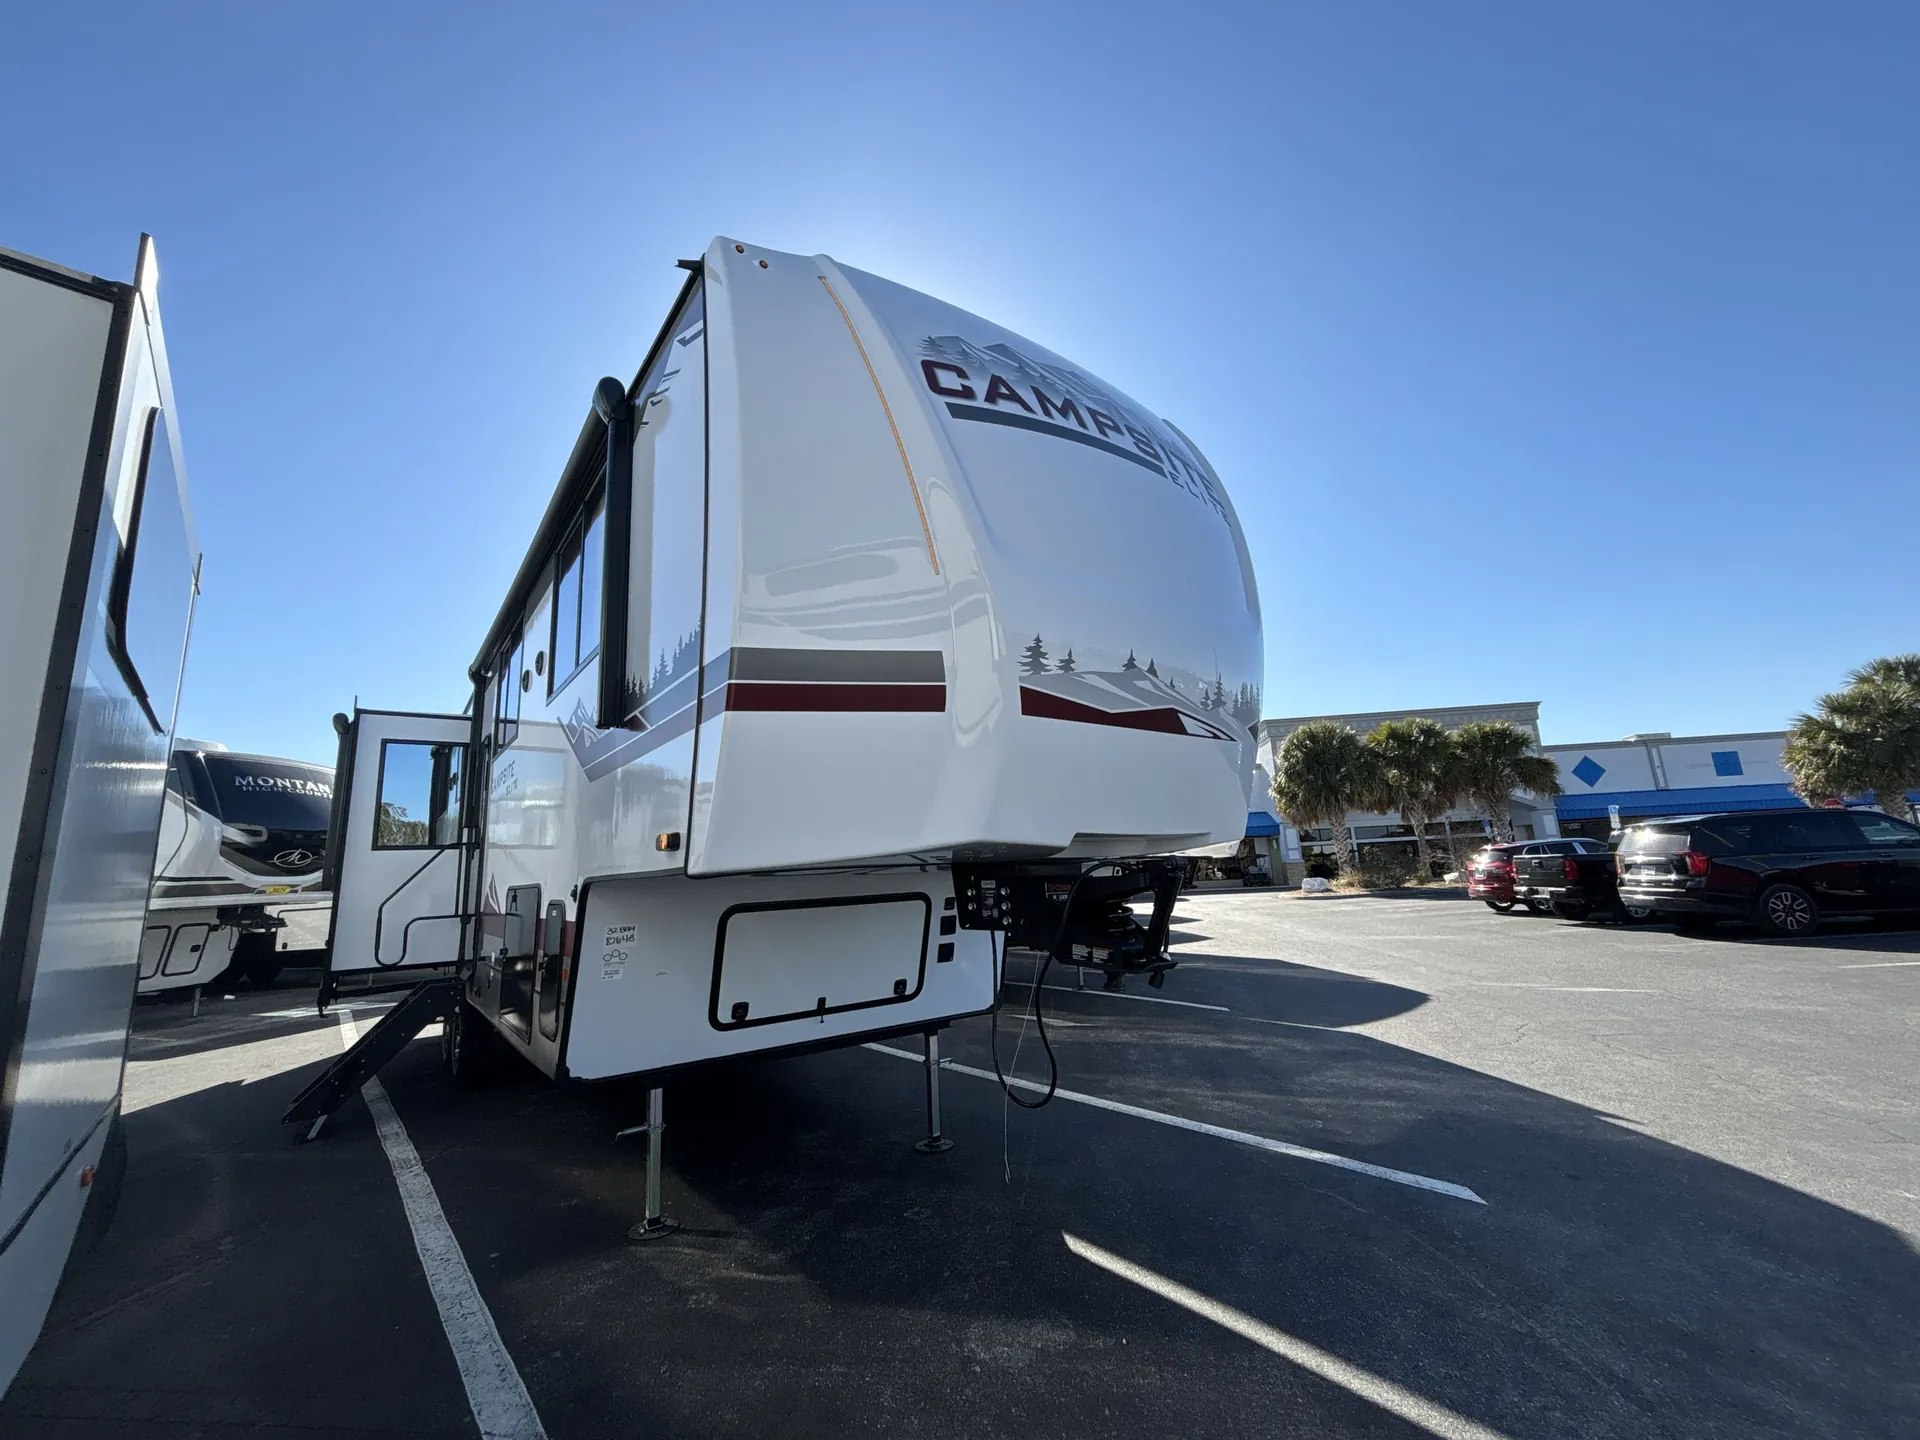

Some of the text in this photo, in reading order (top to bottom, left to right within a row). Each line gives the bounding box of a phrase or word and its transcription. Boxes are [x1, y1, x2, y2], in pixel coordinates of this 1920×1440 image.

[920, 359, 1226, 512] CAMPSITE
[1167, 470, 1232, 527] ELITE
[234, 776, 333, 794] MONTAN
